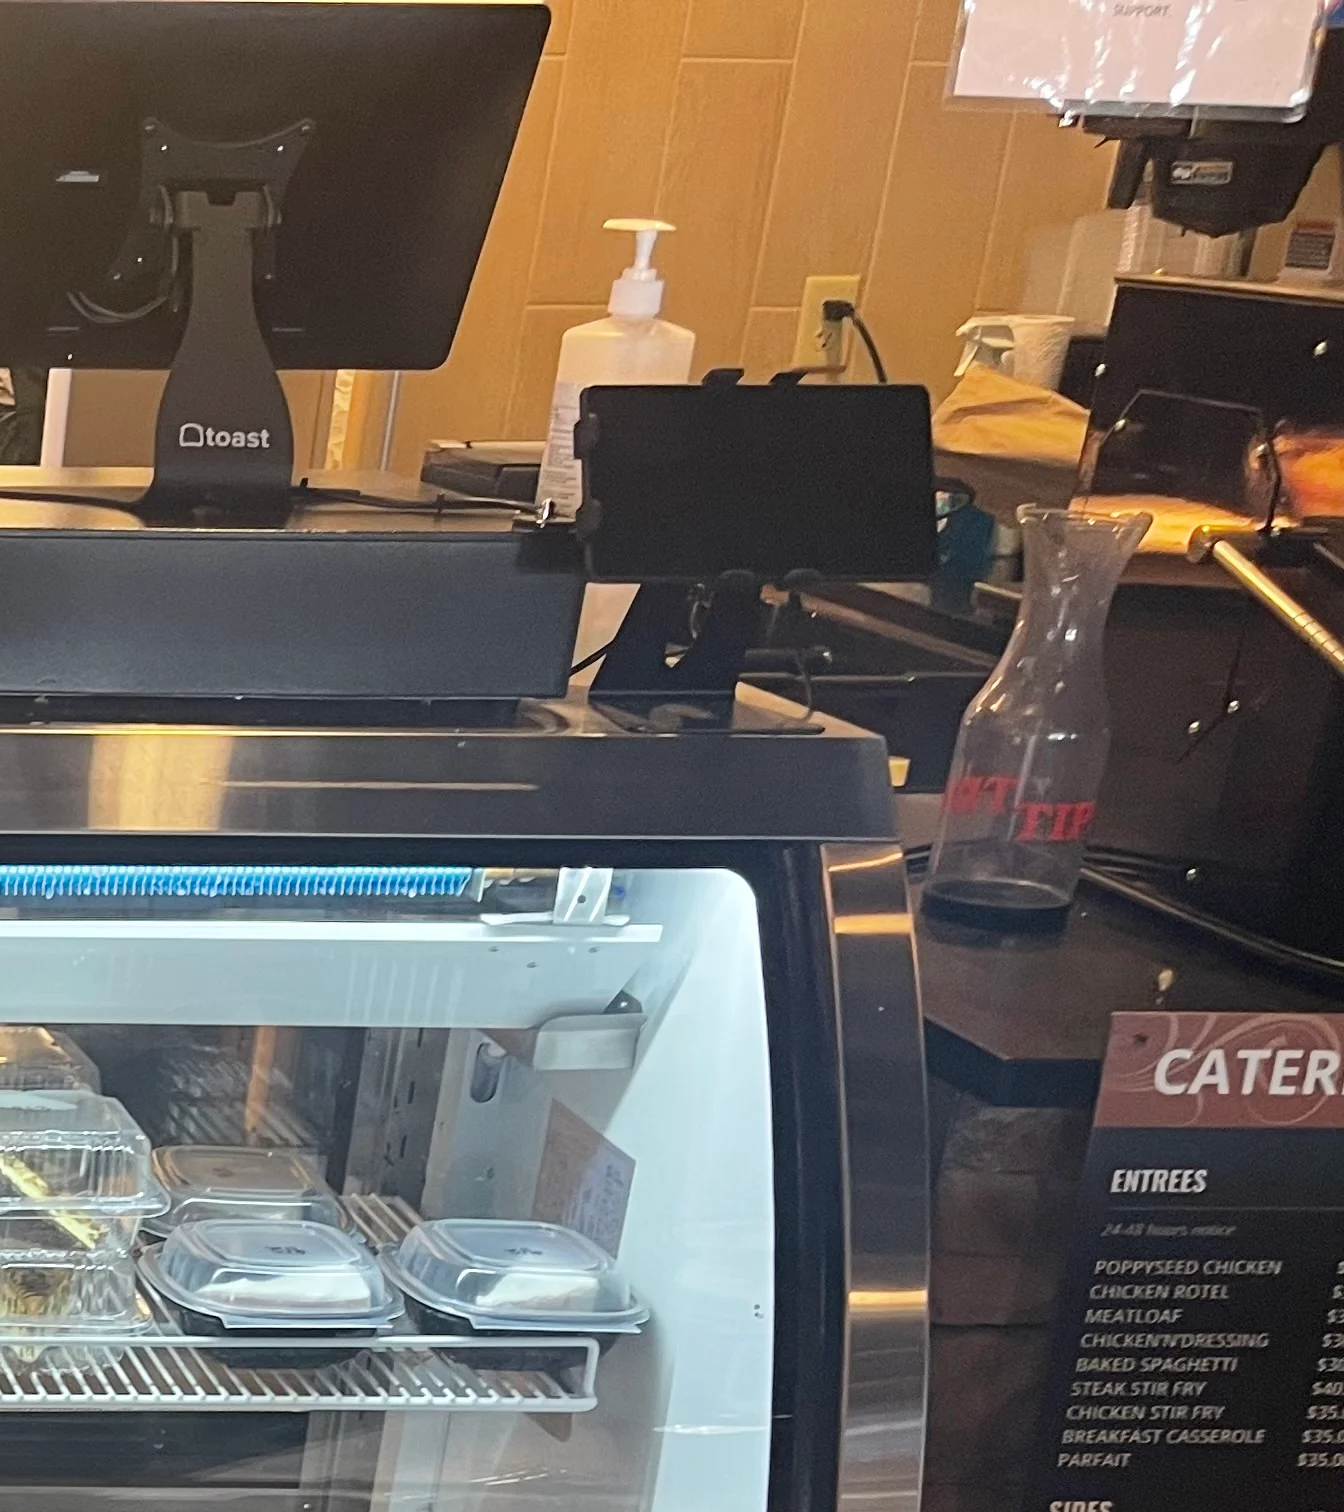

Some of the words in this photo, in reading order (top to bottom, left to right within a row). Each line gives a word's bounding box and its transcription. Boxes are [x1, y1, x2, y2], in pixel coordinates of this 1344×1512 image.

[205, 427, 270, 448] toast
[1016, 801, 1096, 841] TIP
[1154, 1048, 1344, 1095] CATER
[1110, 1169, 1208, 1193] ENTREES
[1094, 1261, 1199, 1275] POPPYSEED
[1203, 1261, 1283, 1275] CHICKEN
[1089, 1285, 1169, 1299] CHICKEN
[1172, 1285, 1230, 1299] ROTEL
[1084, 1309, 1184, 1324] MEATLOAF
[1076, 1358, 1135, 1372] BAKED
[1139, 1358, 1238, 1372] SPAGHETTI
[1070, 1382, 1126, 1396] STEAK
[1130, 1382, 1169, 1396] STIR
[1172, 1382, 1208, 1396] FRY
[1066, 1406, 1146, 1420] CHICKEN
[1150, 1406, 1189, 1420] STIR
[1192, 1406, 1225, 1420] FRY
[1062, 1430, 1164, 1444] BREAKFAST
[1166, 1430, 1265, 1444] CASSEROLE
[1057, 1453, 1132, 1467] PARFAIT
